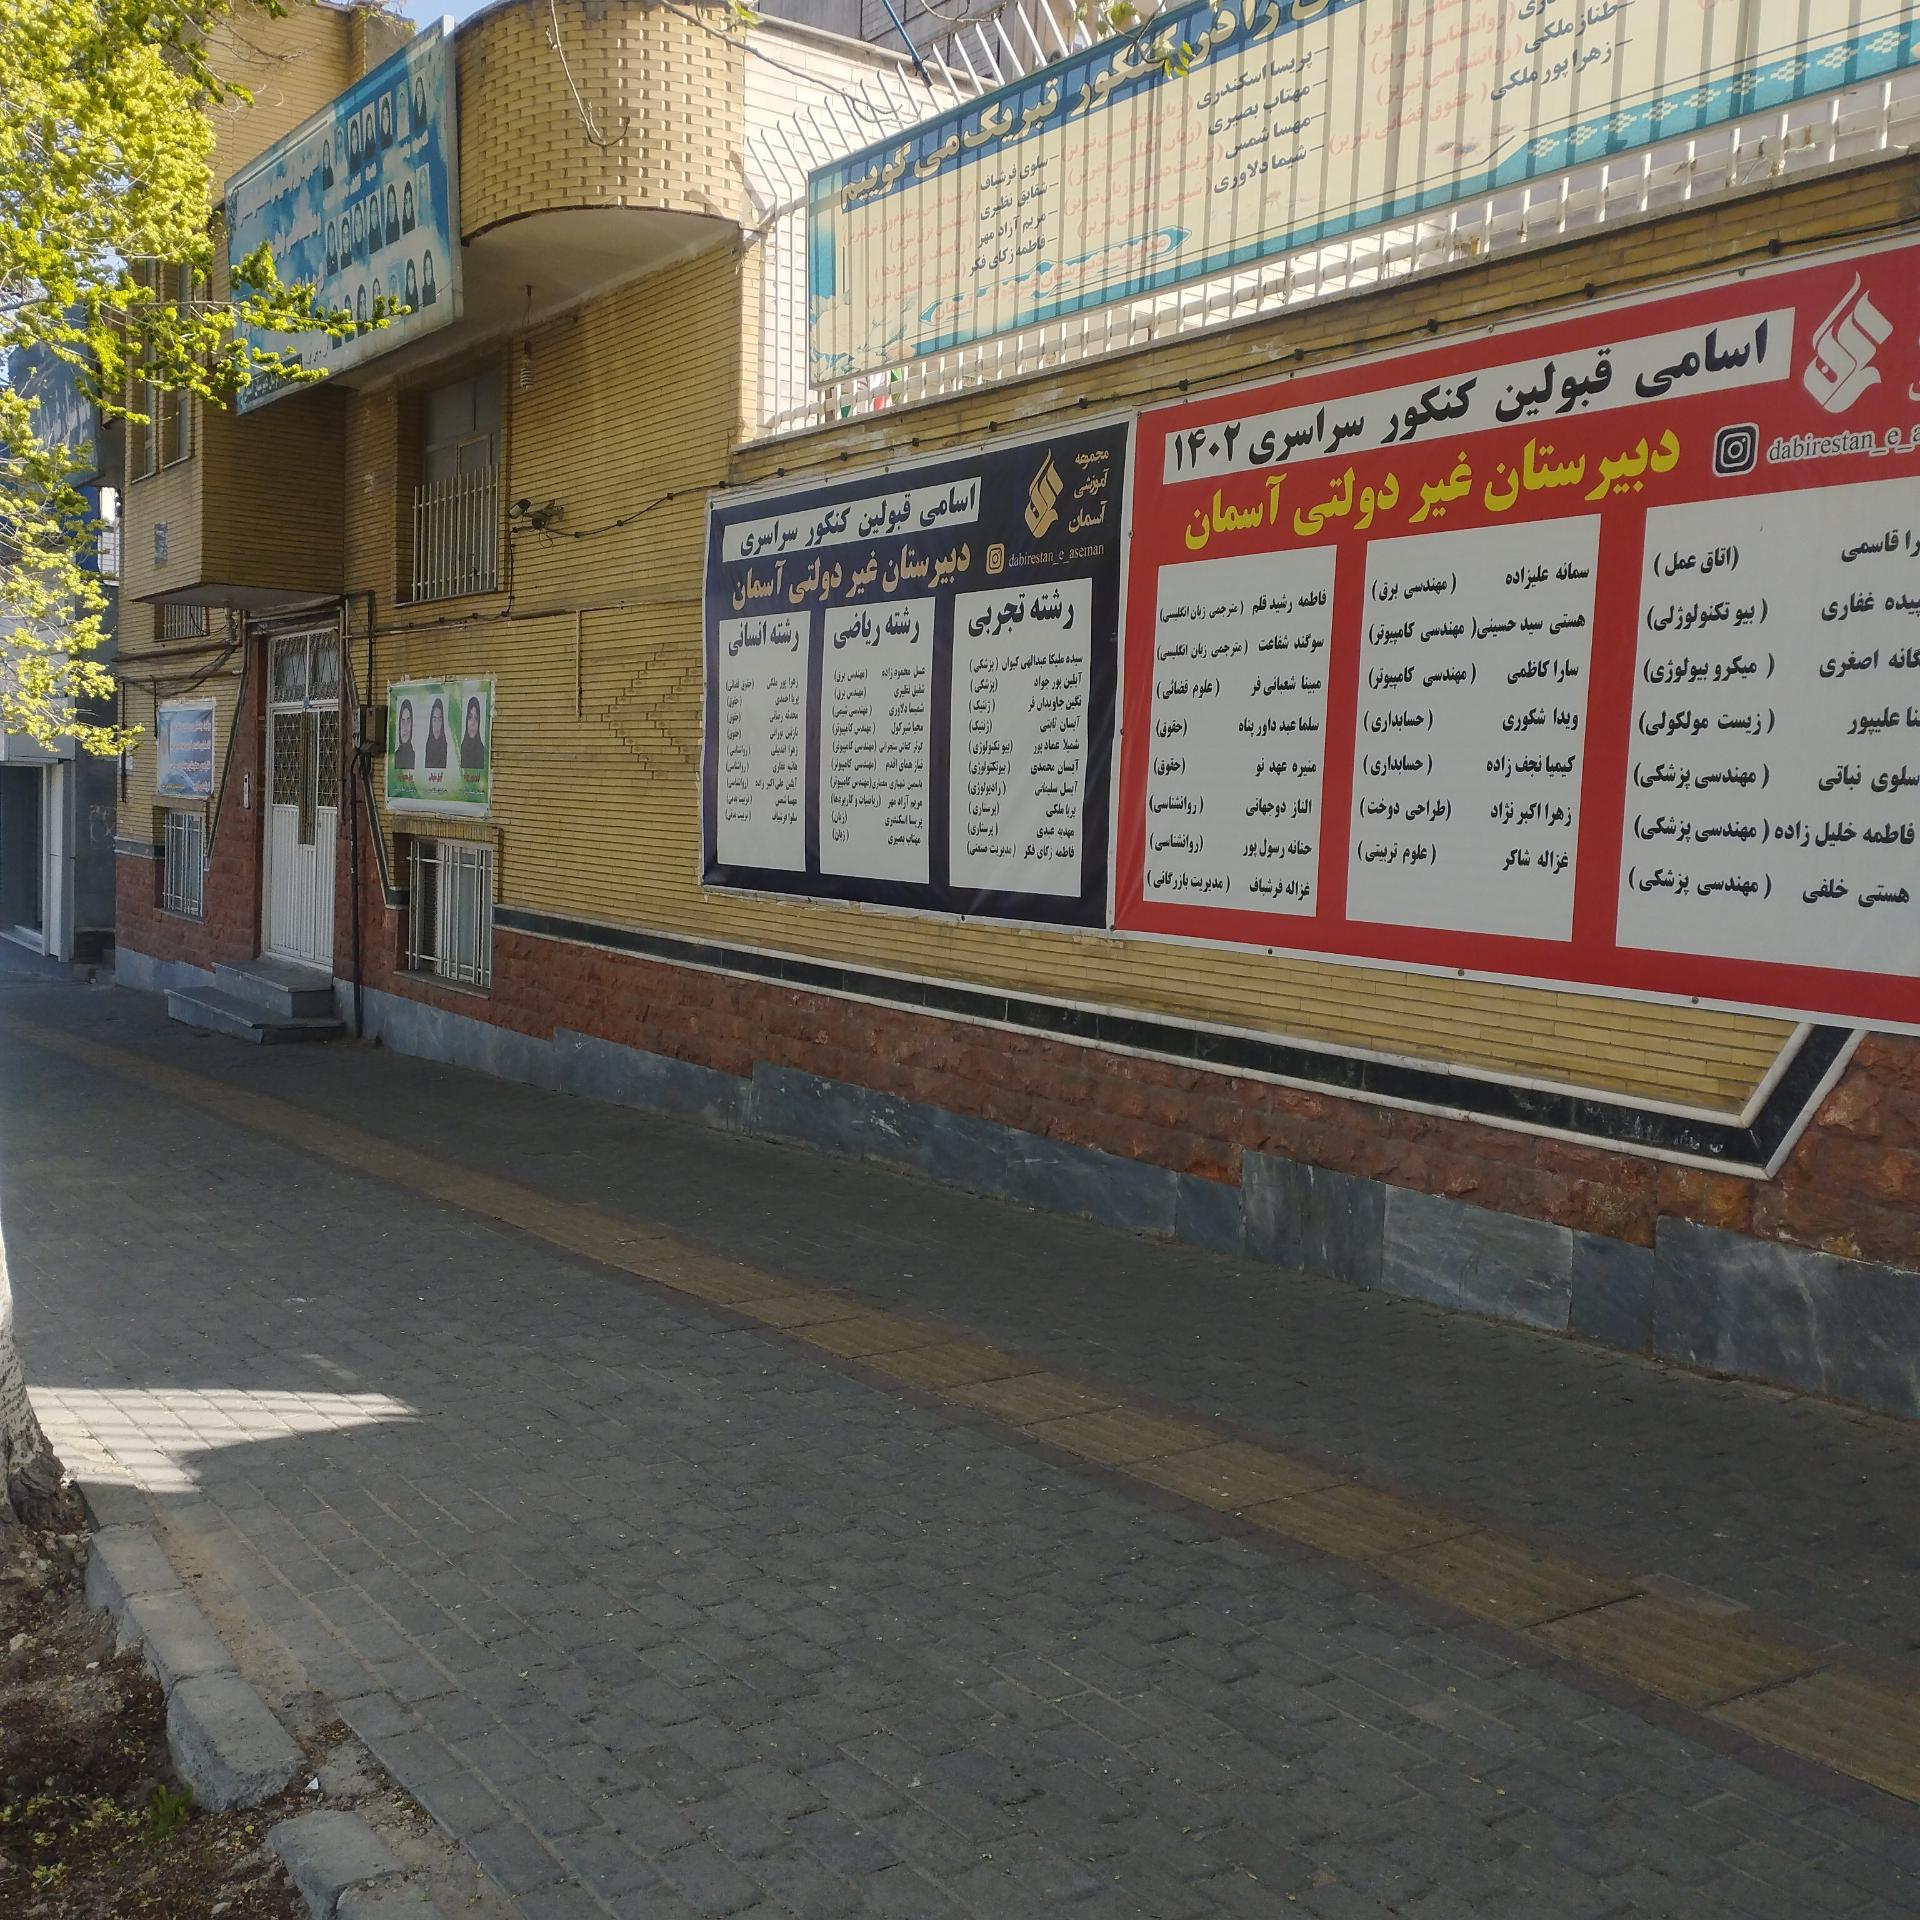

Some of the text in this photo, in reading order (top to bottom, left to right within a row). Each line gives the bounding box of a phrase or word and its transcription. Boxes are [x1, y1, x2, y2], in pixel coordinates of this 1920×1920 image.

[1575, 3, 1618, 37] طناز
[1524, 20, 1574, 53] ملکی
[1541, 53, 1569, 82] پور
[1574, 42, 1612, 74] زهرا
[1264, 84, 1311, 111] مهتاب
[1490, 70, 1538, 101] ملکی
[964, 77, 1059, 148] تبریک
[1208, 103, 1259, 135] بصیری
[1225, 117, 1311, 160] مهسا شمس
[913, 134, 960, 179] می
[1214, 147, 1307, 194] شیما دلاوری
[841, 142, 911, 210] گوییم
[978, 213, 1046, 248] مریم آزاد مهر
[1174, 318, 1768, 471] اسامی قبولین کنکور سراسری ۱۴۰۲
[1075, 450, 1109, 469] مجموعه
[1074, 468, 1109, 498] آموزشی
[1185, 429, 1680, 550] دبیرستان غیر دولتی آسمان
[740, 482, 976, 556] اسامی قبولین کنکور سراسری
[1068, 500, 1107, 533] آسمان
[1008, 543, 1105, 569] dabirestan_e_aseman
[1841, 530, 1899, 563] قاسمی
[732, 543, 970, 611] دبیرستان غیر دولتی آسمان
[1505, 562, 1590, 590] سمانه علیزاده
[968, 588, 1074, 637] رشته تجربی
[1252, 589, 1327, 615] فاطمه رشید قلم
[1821, 592, 1874, 620] غفاری
[729, 618, 799, 656] رشته انسانی
[834, 606, 920, 649] رشته ریاضی
[1477, 613, 1585, 639] هستی سید حسینی
[1258, 634, 1324, 653] سوگند شفاعت
[1507, 658, 1579, 684] سارا کاظمی
[1819, 649, 1879, 677] اصغری
[1250, 674, 1321, 696] مبینا شعبانی فر
[1238, 716, 1319, 738] سلما عبد داور پناه
[1502, 707, 1578, 731] ویدا شکوری
[1847, 707, 1900, 735] علیپور
[1255, 758, 1317, 777] منیره عهد نو
[1486, 755, 1576, 778] کیمیا نجف زاده
[1819, 764, 1861, 791] نباتی
[1245, 797, 1312, 818] الناز دوجهانی
[1491, 801, 1572, 827] زهرا اکبر نژاد
[1774, 821, 1810, 847] زاده
[1815, 821, 1857, 847] خلیل
[1863, 822, 1915, 844] فاطمه
[1243, 838, 1312, 858] حنانه رسول پور
[1502, 849, 1569, 875] غزاله شاکر
[1250, 876, 1310, 900] غزاله فرشباف
[1803, 879, 1909, 907] هستی خلفی
